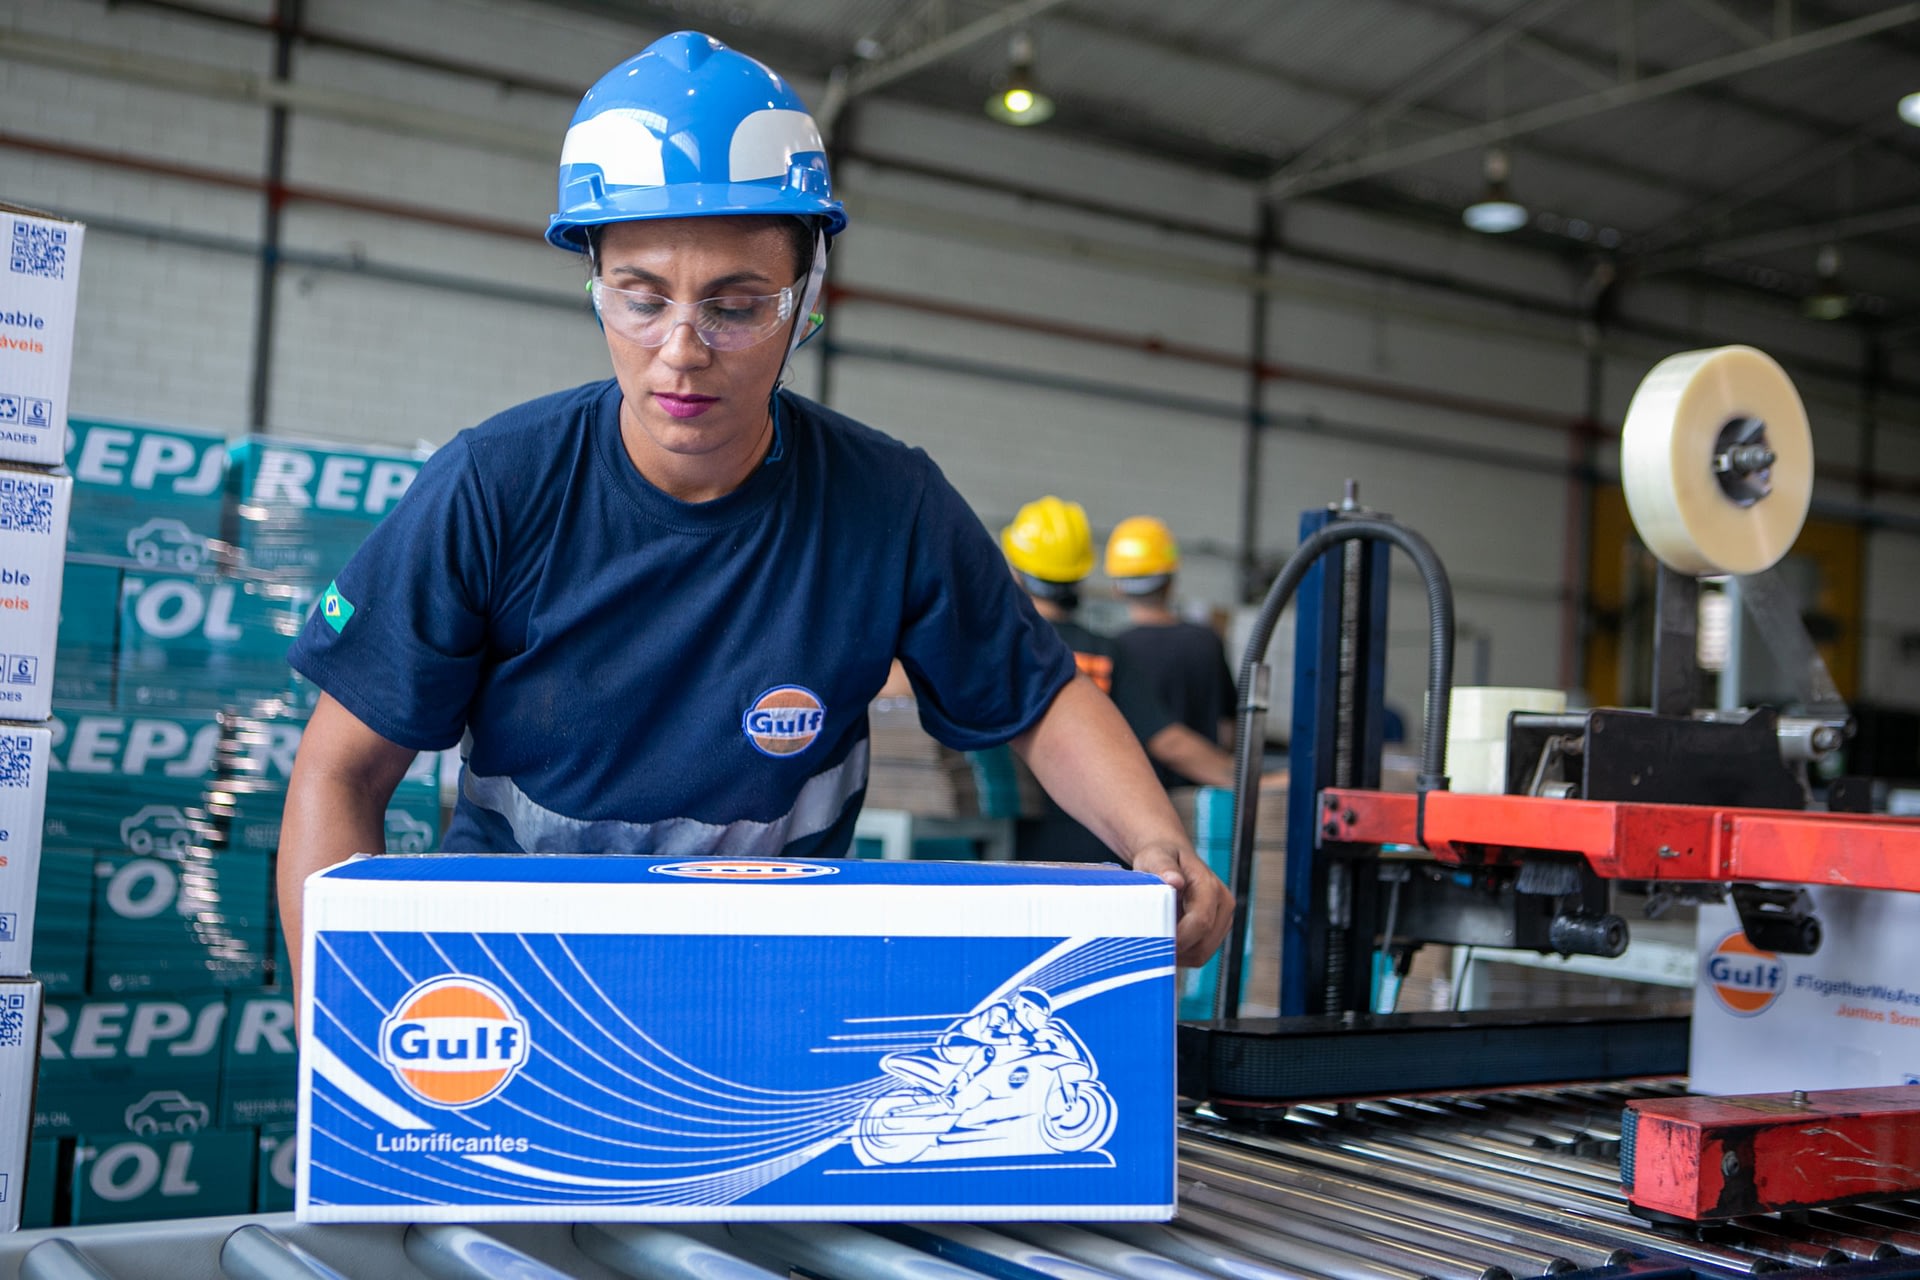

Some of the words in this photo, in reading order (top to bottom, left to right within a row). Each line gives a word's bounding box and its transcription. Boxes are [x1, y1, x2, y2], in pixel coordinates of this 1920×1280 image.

[32, 401, 44, 418] 6
[65, 424, 231, 496] EPS
[18, 659, 29, 675] 6
[749, 711, 822, 733] Gulf
[1708, 956, 1782, 989] Gulf
[389, 1023, 518, 1060] Gulf
[376, 1132, 529, 1152] Lubrificantes
